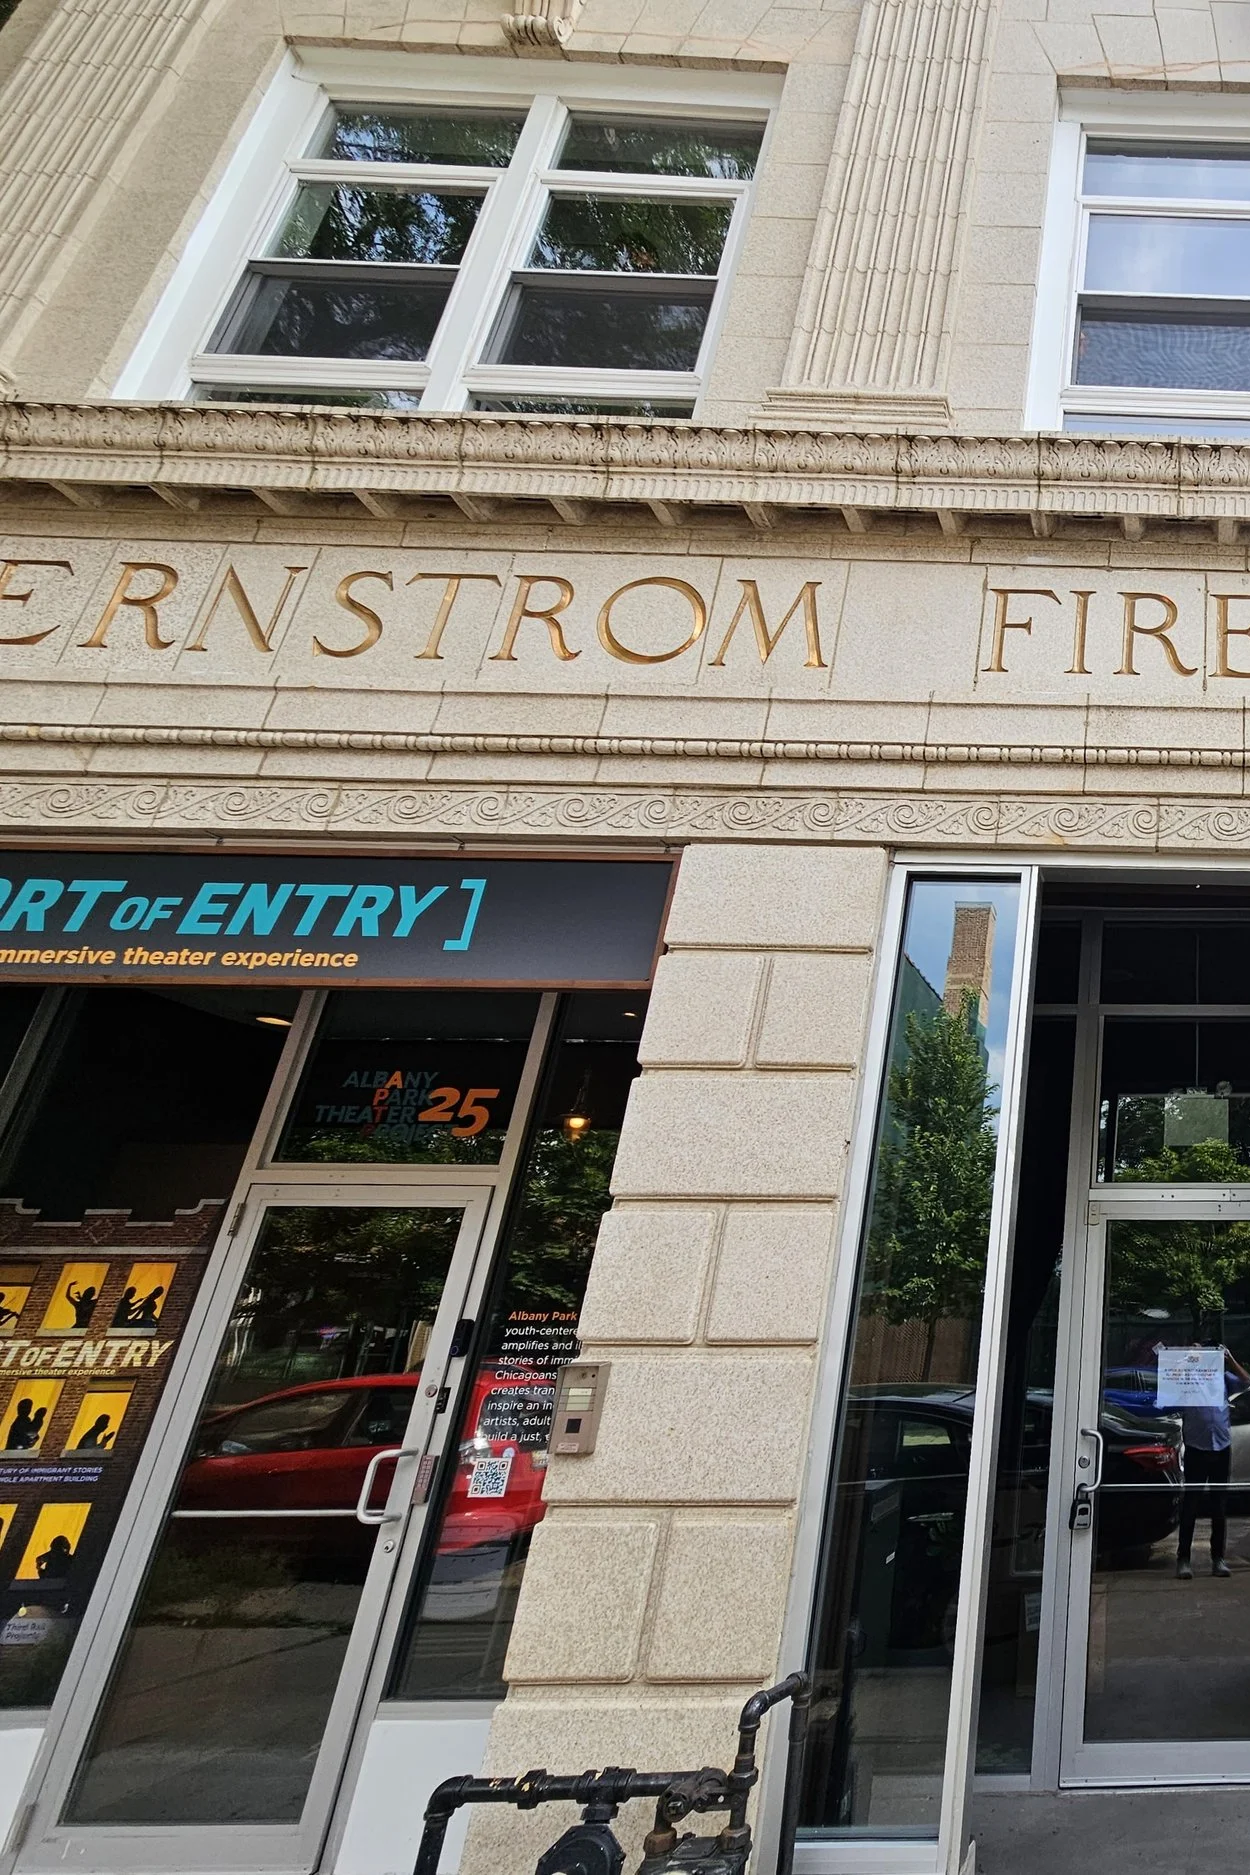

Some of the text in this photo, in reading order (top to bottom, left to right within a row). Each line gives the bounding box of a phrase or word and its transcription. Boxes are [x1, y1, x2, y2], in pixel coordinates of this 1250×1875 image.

[0, 878, 128, 932] RT
[109, 896, 184, 931] OF
[122, 946, 215, 967] theater
[221, 948, 359, 970] experience
[343, 1071, 440, 1088] ALBANY
[315, 1105, 417, 1124] THEATER
[373, 1087, 500, 1137] PARK 25
[508, 1311, 578, 1322] Albany Park
[501, 1341, 549, 1352] amplifies
[551, 1341, 573, 1350] and
[20, 1347, 58, 1367] OF
[51, 1340, 175, 1368] ENTRY
[498, 1356, 534, 1366] stories
[536, 1355, 550, 1365] of
[34, 1368, 66, 1376] theater
[68, 1368, 116, 1377] experience
[495, 1370, 557, 1381] Chicagoans
[491, 1386, 530, 1395] creates
[487, 1400, 524, 1412] inspire
[526, 1402, 539, 1410] an
[483, 1417, 520, 1427] artists,
[518, 1432, 542, 1443] just,
[64, 1475, 99, 1483] BUILDING
